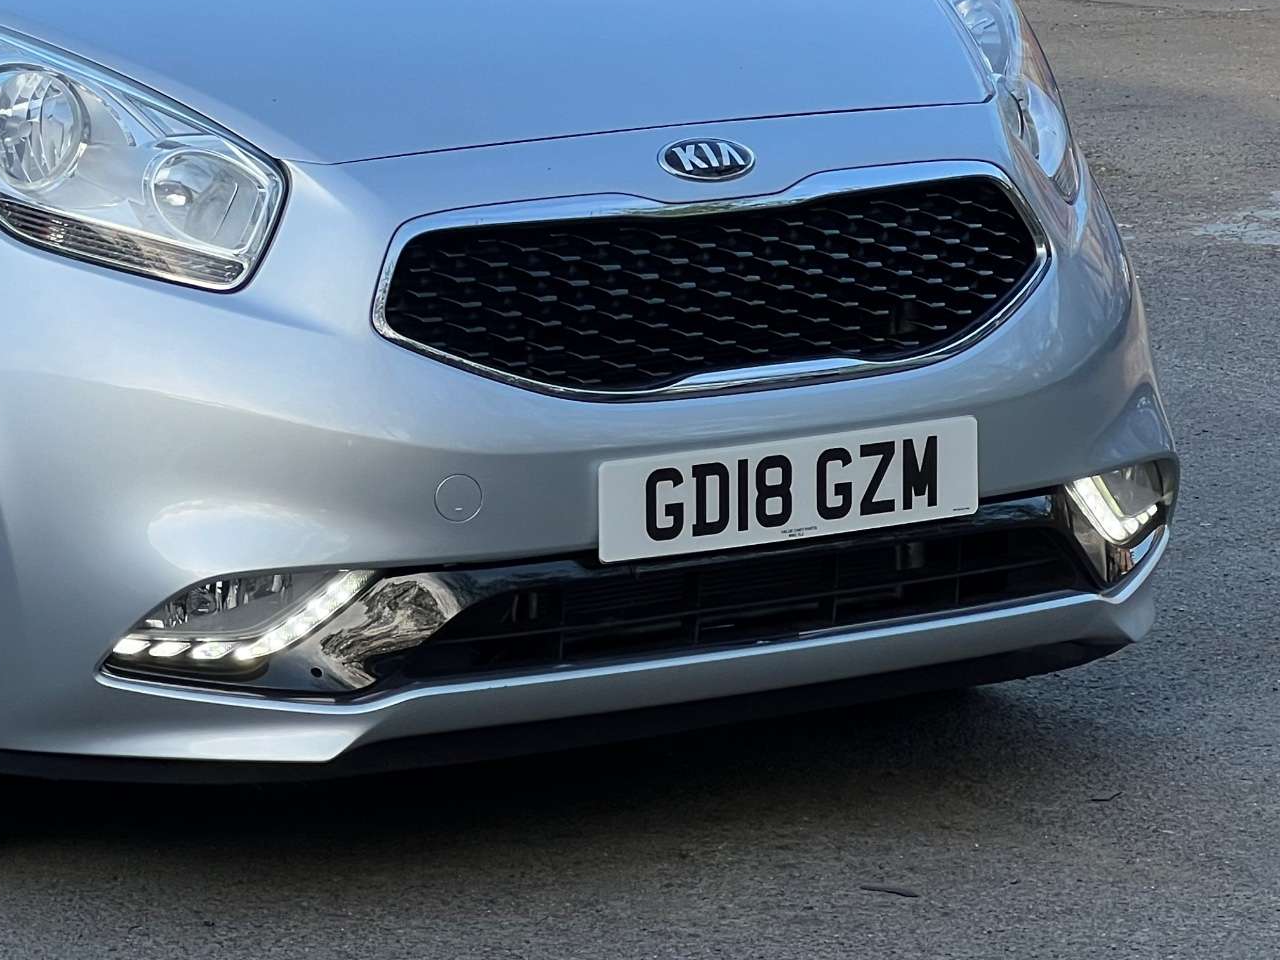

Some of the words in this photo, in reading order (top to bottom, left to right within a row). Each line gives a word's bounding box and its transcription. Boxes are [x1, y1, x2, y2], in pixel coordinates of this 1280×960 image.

[671, 142, 745, 171] KIA
[645, 453, 793, 542] GD18
[816, 435, 938, 521] GZM
